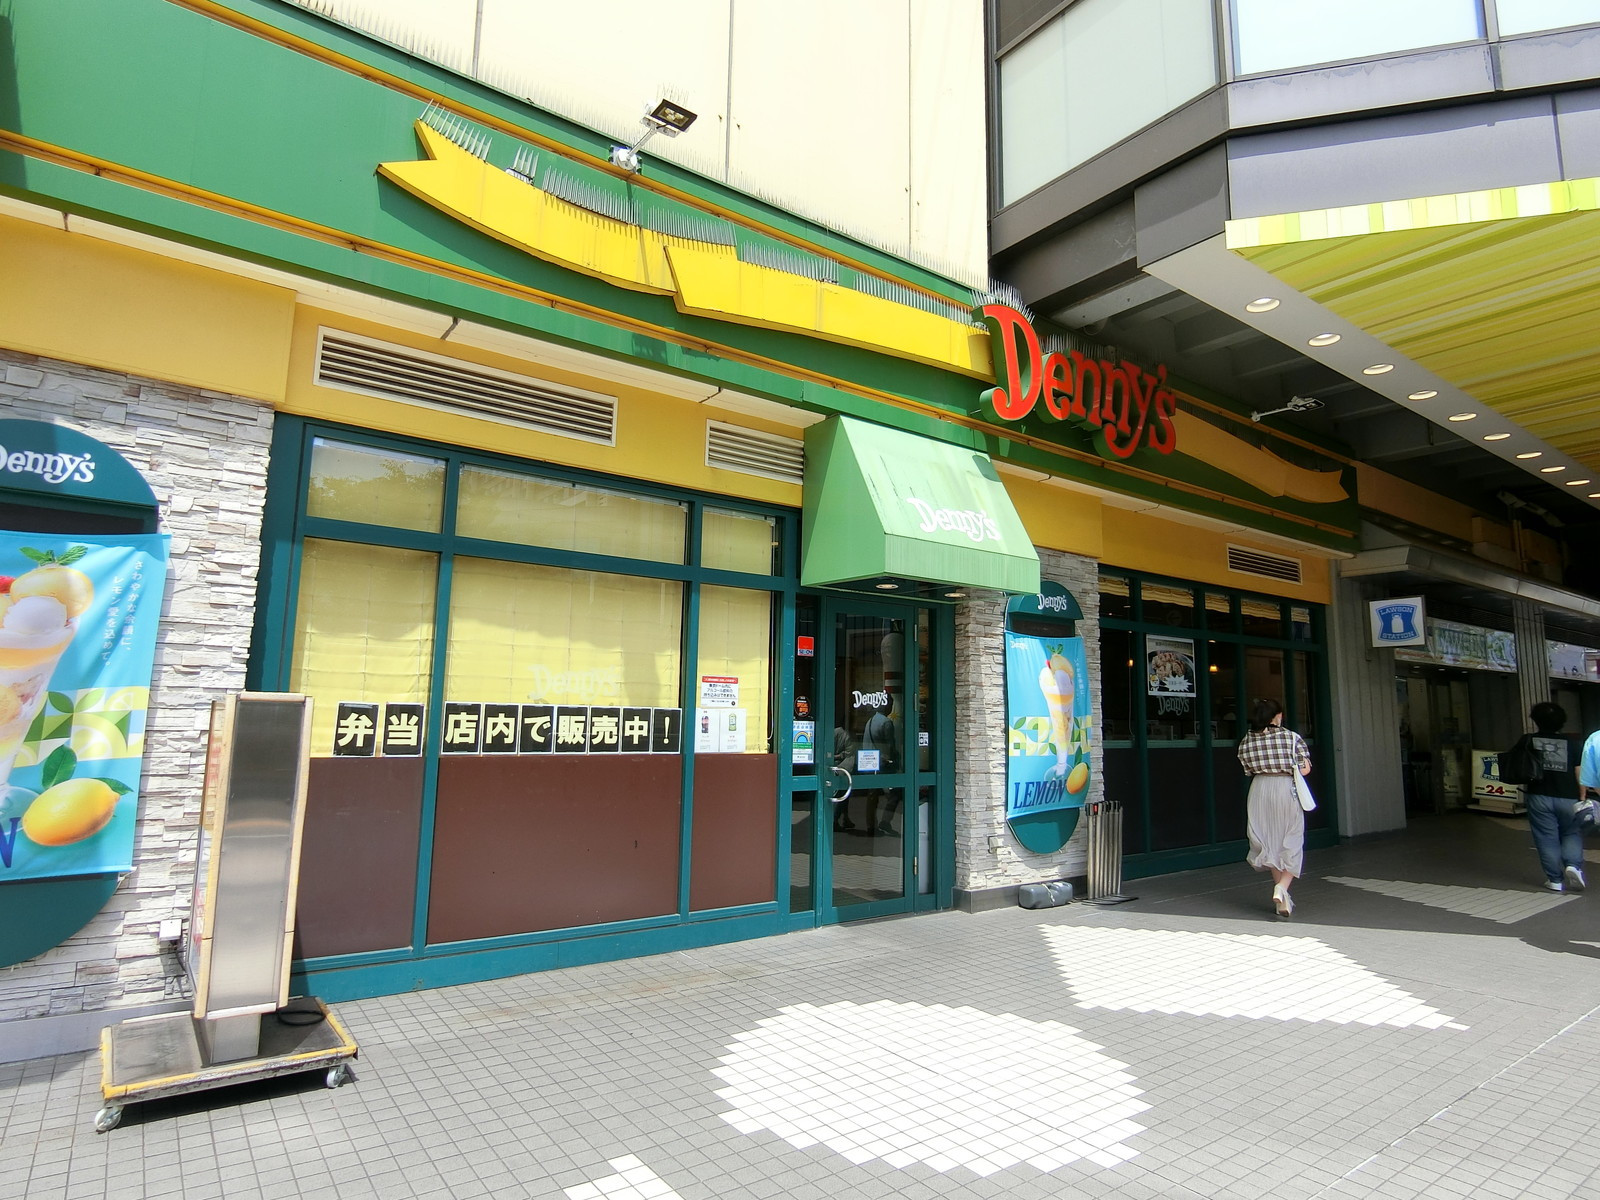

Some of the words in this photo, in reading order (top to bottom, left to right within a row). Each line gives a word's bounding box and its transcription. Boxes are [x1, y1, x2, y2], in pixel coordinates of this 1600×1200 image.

[982, 304, 1176, 458] Denny's
[906, 497, 1001, 542] Denny's
[1036, 593, 1067, 612] Denny's
[1379, 606, 1413, 615] LAWSON
[1382, 631, 1415, 640] STATION
[528, 663, 620, 702] Denny's
[852, 690, 889, 709] Denny's
[337, 712, 419, 748] 弁当
[444, 712, 672, 746] 店内で販売中!
[1013, 778, 1067, 810] LEMON
[1486, 784, 1505, 795] 24
